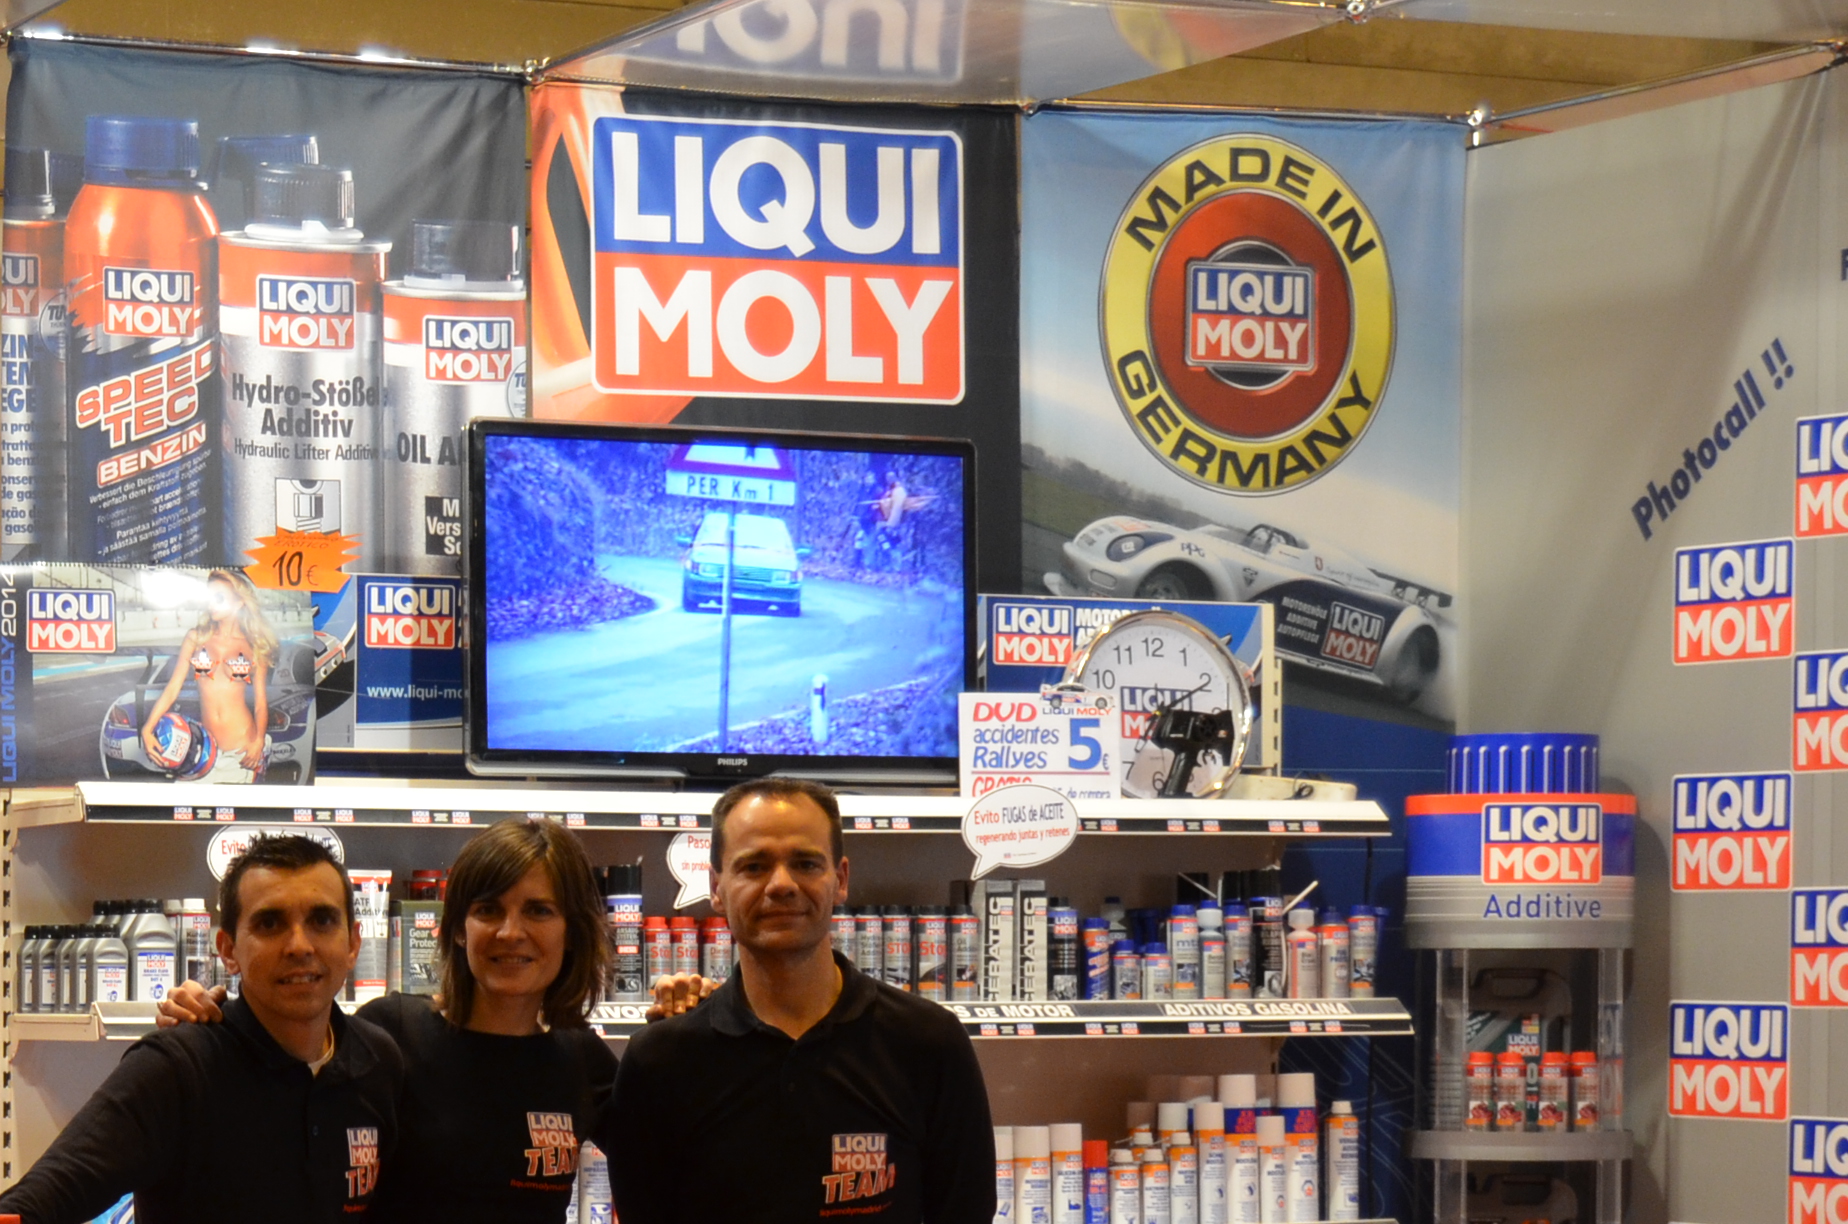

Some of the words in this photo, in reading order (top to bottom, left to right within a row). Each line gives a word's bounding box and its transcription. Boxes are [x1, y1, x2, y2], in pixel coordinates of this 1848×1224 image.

[612, 132, 941, 257] LIQUI
[1125, 146, 1316, 253] MADE
[1316, 189, 1377, 263] IN
[108, 271, 191, 303] LIQUI
[262, 279, 351, 314] LIQUI
[1197, 271, 1304, 316] LIQUI
[109, 304, 192, 334] MOLY
[263, 315, 353, 348] MOLY
[427, 319, 509, 350] LIQUI
[614, 266, 954, 385] MOLY
[1197, 319, 1307, 360] MOLY
[428, 348, 511, 381] MOLY
[101, 383, 198, 448] TEC
[261, 408, 353, 438] Additiv
[1117, 349, 1373, 487] GERMANY
[99, 423, 206, 484] BENZIN
[234, 438, 290, 460] Hydraulic
[295, 443, 330, 460] Lifter
[397, 432, 431, 464] OIL
[1630, 367, 1767, 541] Photocall
[687, 477, 718, 496] PER
[732, 480, 758, 500] Km
[768, 484, 774, 500] 1
[1678, 544, 1788, 601] LIQUI
[2, 571, 17, 636] 2014
[32, 593, 109, 621] LIQUI
[369, 583, 452, 616] LIQUI
[32, 623, 111, 649] MOLY
[369, 616, 454, 646] MOLY
[998, 607, 1069, 635] LIQUI
[1333, 607, 1381, 640] LIQUI
[1677, 603, 1790, 659] MOLY
[998, 637, 1072, 663] MOLY
[1113, 645, 1133, 665] 11
[1141, 637, 1164, 657] 12
[1326, 633, 1378, 664] MOLY
[2, 640, 16, 705] MOLY
[1092, 669, 1115, 689] 10
[973, 702, 1037, 722] DVD
[1042, 707, 1074, 716] LIQUI
[1076, 707, 1113, 716] MOLY
[3, 716, 17, 782] LIQUI
[973, 725, 1060, 745] accidentes
[717, 758, 748, 767] PHILIPS
[973, 746, 1048, 773] Rallyes
[974, 809, 1000, 825] Evito
[1002, 806, 1026, 824] FUGAS
[1029, 805, 1038, 820] de
[1039, 802, 1064, 820] ACEITE
[1677, 777, 1786, 832] LIQUI
[1489, 806, 1596, 843] LIQUI
[1489, 846, 1599, 880] MOLY
[1676, 836, 1788, 886] MOLY
[1484, 894, 1602, 919] Additive
[974, 1007, 998, 1018] DE
[1002, 1004, 1075, 1018] MOTOR
[1163, 1002, 1252, 1018] ADITIVOS
[1255, 1001, 1352, 1017] GASOLINA
[1673, 1007, 1783, 1060] LIQUI
[1672, 1063, 1784, 1115] MOLY
[530, 1114, 573, 1131] LIQUI
[532, 1131, 577, 1147] MOLY
[834, 1135, 886, 1152] LIQUI
[835, 1153, 886, 1170] MOLY
[822, 1163, 896, 1204] TEAM
